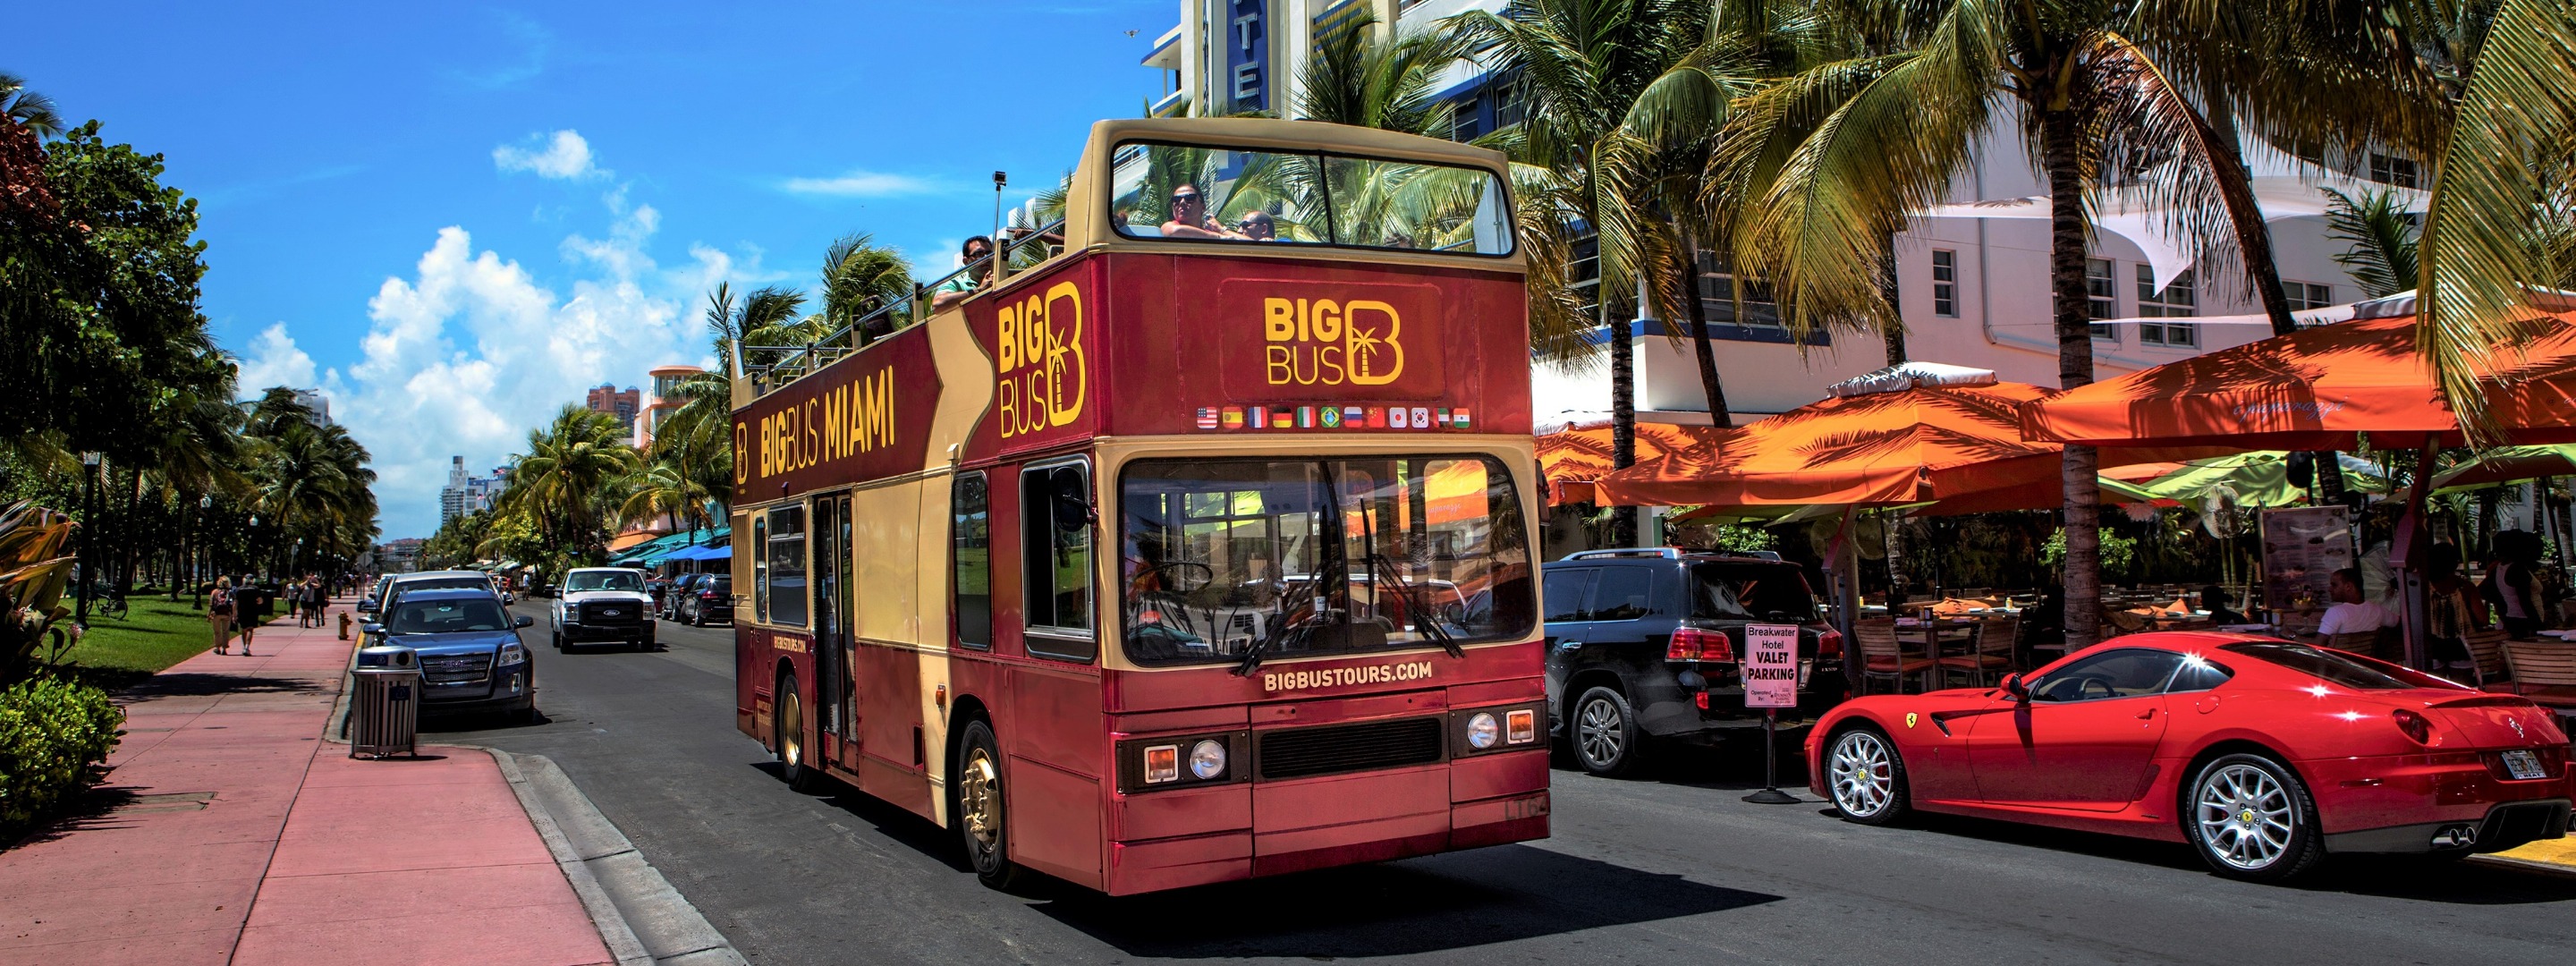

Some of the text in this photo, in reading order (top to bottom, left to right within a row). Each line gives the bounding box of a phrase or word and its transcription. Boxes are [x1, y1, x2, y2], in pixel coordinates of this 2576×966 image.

[1233, 0, 1258, 99] TE
[998, 294, 1044, 374] BIG
[1264, 297, 1342, 342] BIG
[1266, 345, 1344, 386] BUS
[825, 365, 895, 462] MIAMI
[1000, 369, 1047, 439] BUS
[2240, 394, 2349, 423] paparazzi
[1748, 627, 1795, 637] Breakwater
[1761, 640, 1784, 649] Hotel
[1748, 667, 1794, 681] PARKING
[1756, 651, 1789, 664] VALET
[1265, 661, 1432, 691] BIGBUSTOURS.COM
